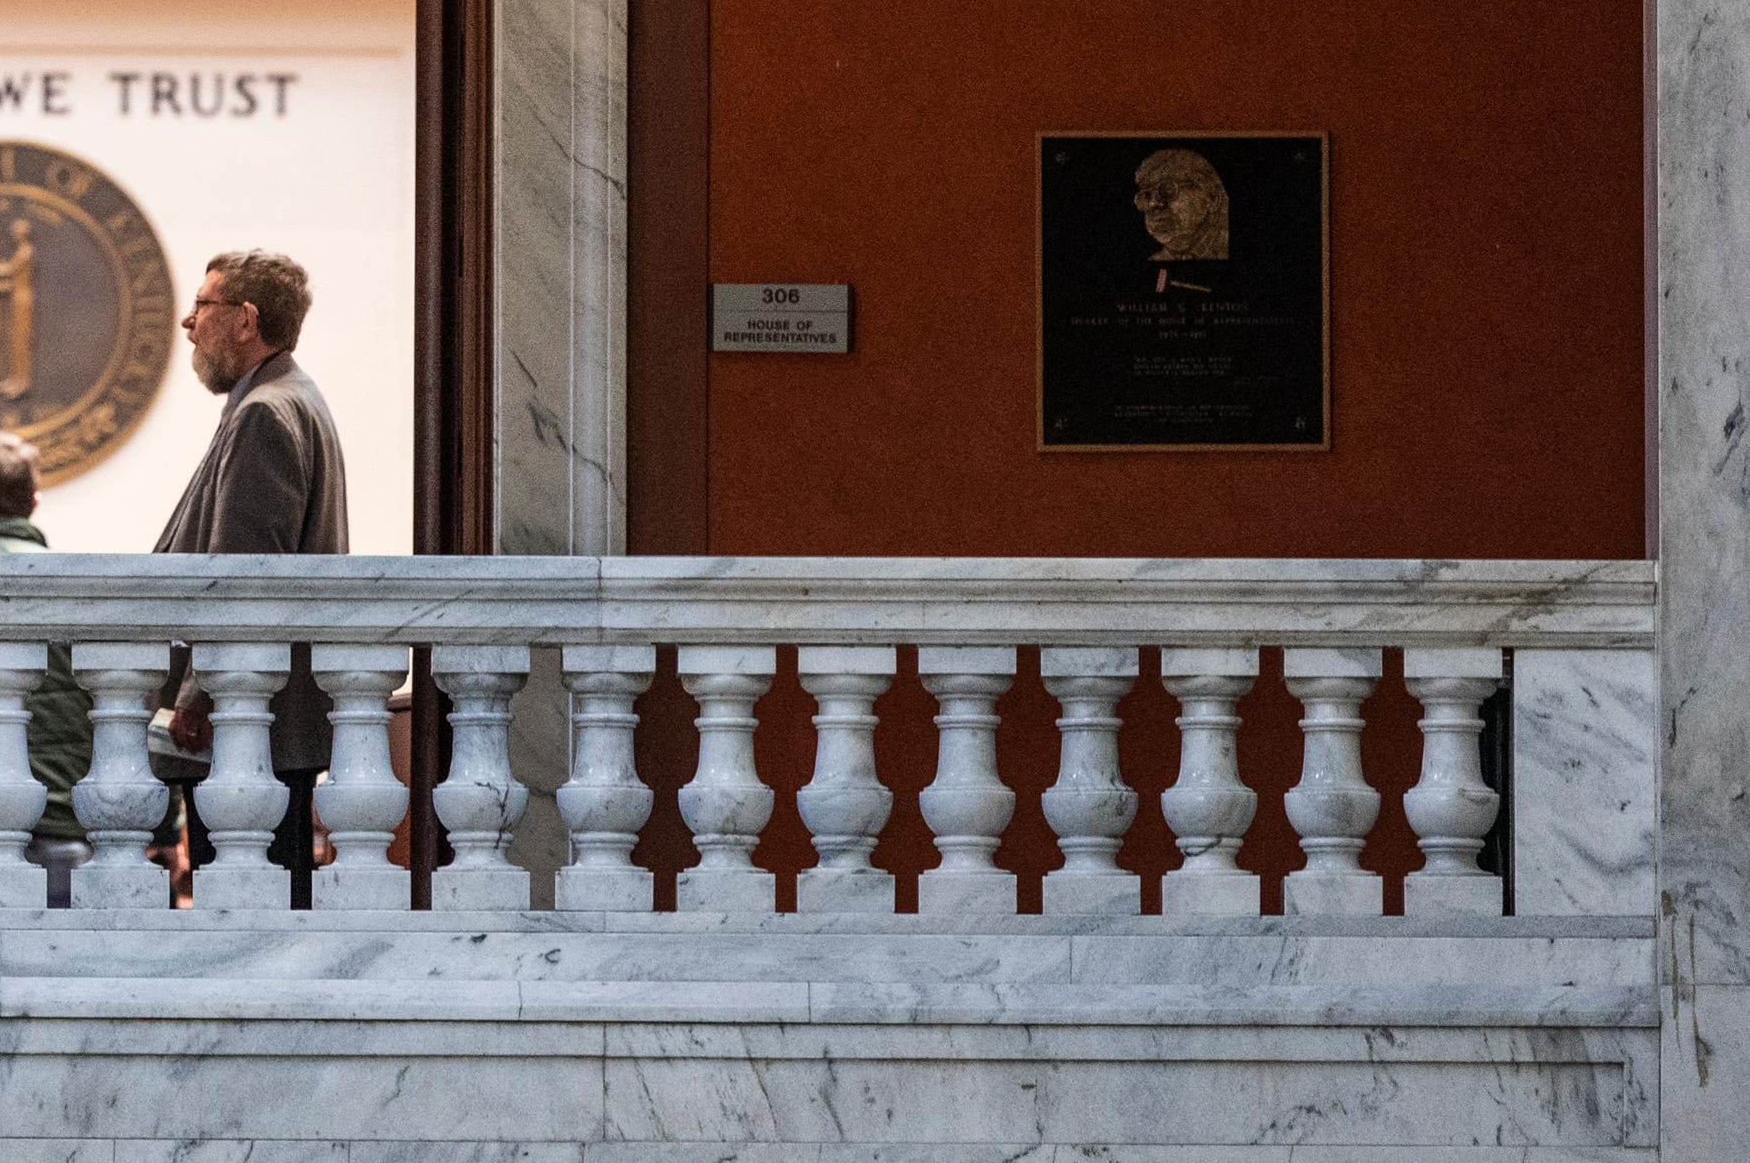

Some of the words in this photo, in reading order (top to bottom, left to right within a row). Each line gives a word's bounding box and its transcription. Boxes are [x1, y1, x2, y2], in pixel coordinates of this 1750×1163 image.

[109, 71, 301, 118] TRUST
[761, 288, 801, 304] 306
[748, 319, 790, 331] HOUSE
[796, 319, 814, 331] OF
[723, 331, 838, 344] REPRESENTATIVES
